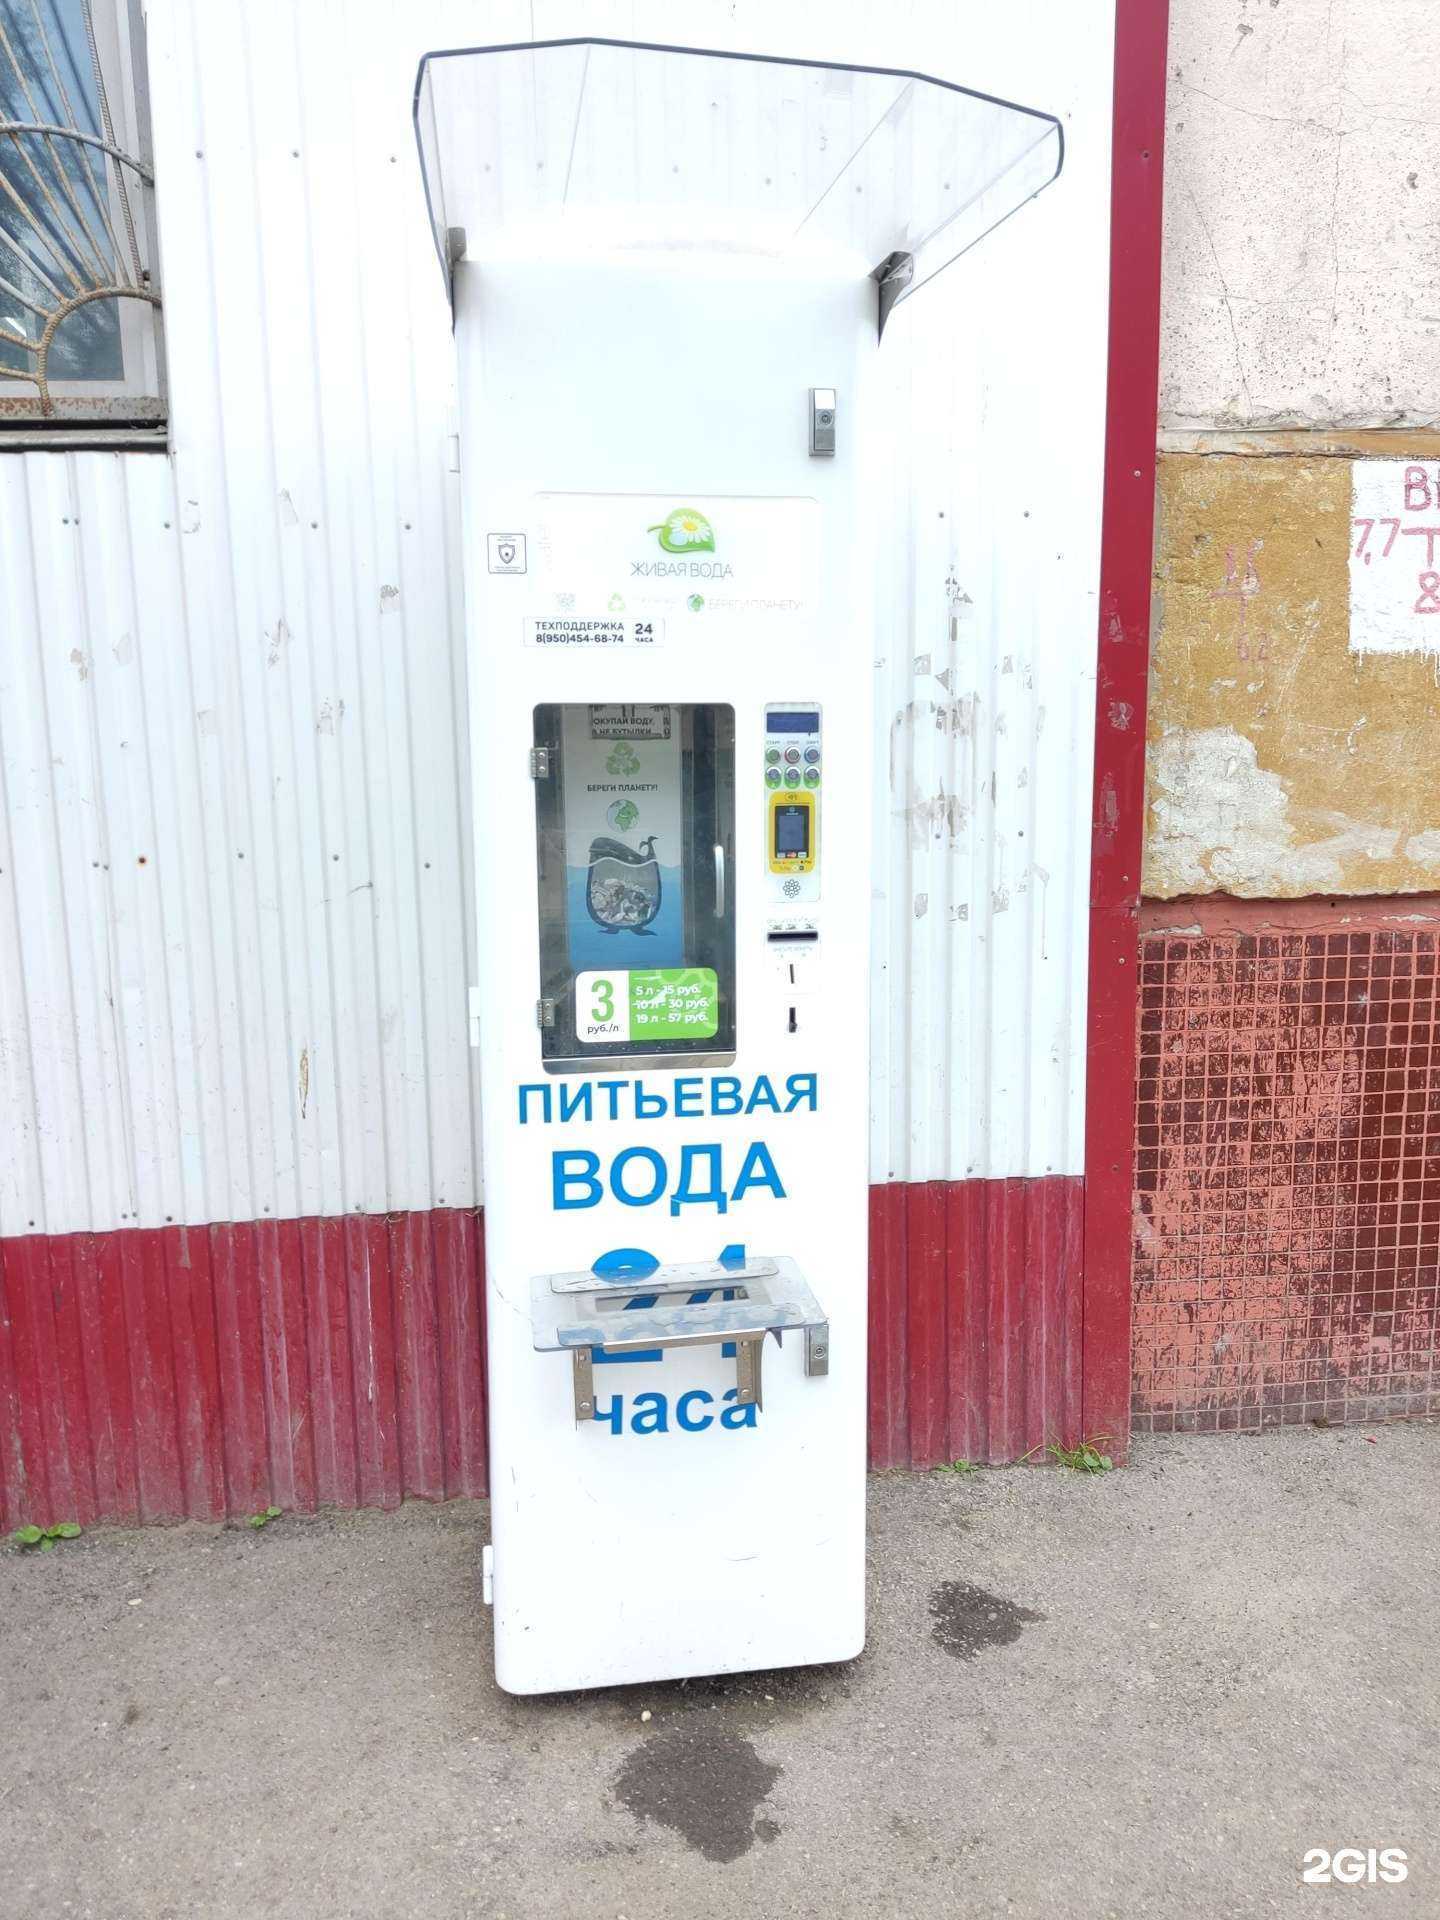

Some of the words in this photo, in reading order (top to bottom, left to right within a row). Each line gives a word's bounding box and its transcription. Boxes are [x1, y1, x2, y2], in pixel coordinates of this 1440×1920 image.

[630, 561, 687, 577] ЖИВАЯ
[690, 561, 734, 579] ВОДА
[535, 621, 625, 631] ТЕХПОДДЕРЖКА
[635, 623, 653, 634] 24
[535, 633, 625, 644] 8(950)454-68-74
[587, 784, 616, 792] БЕРЕГИ
[635, 985, 644, 996] 5
[645, 987, 653, 995] л
[677, 983, 702, 996] руб.
[591, 979, 614, 1022] 3
[668, 998, 683, 1009] 30
[686, 997, 709, 1010] руб.
[636, 1012, 648, 1023] 19
[651, 1014, 659, 1023] л
[668, 1011, 681, 1023] 57
[685, 1011, 708, 1024] руб.
[587, 1023, 619, 1035] руб./л
[518, 1073, 818, 1125] ПИТЬЕВАЯ
[551, 1141, 787, 1217] ВОДА
[592, 1388, 759, 1436] часа
